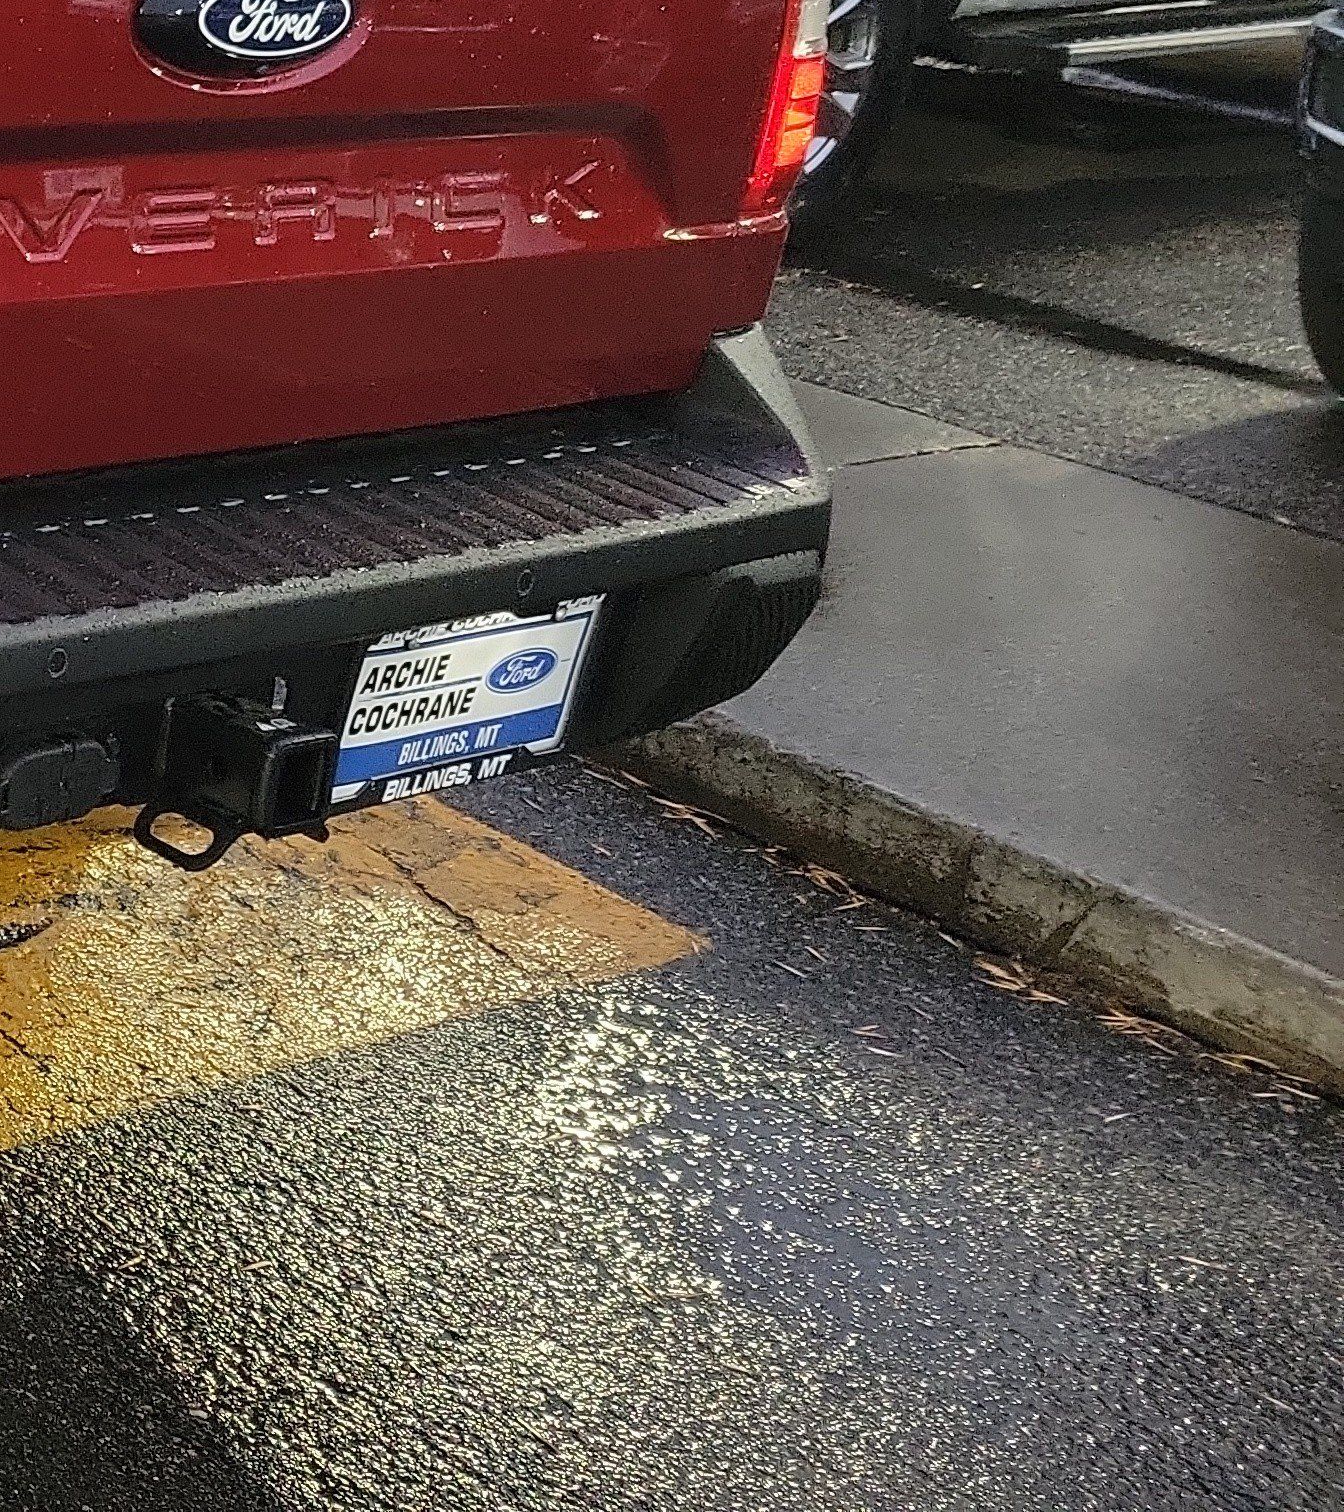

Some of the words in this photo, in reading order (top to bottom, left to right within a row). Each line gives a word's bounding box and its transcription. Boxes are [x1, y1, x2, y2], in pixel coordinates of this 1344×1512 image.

[361, 654, 452, 694] ARCHIE
[498, 656, 547, 687] Ford
[348, 687, 478, 737] COCHRANE
[397, 728, 470, 766] BILLINGS,
[473, 723, 504, 749] MT
[381, 761, 473, 803] BILLINGS,
[476, 754, 513, 778] MT
